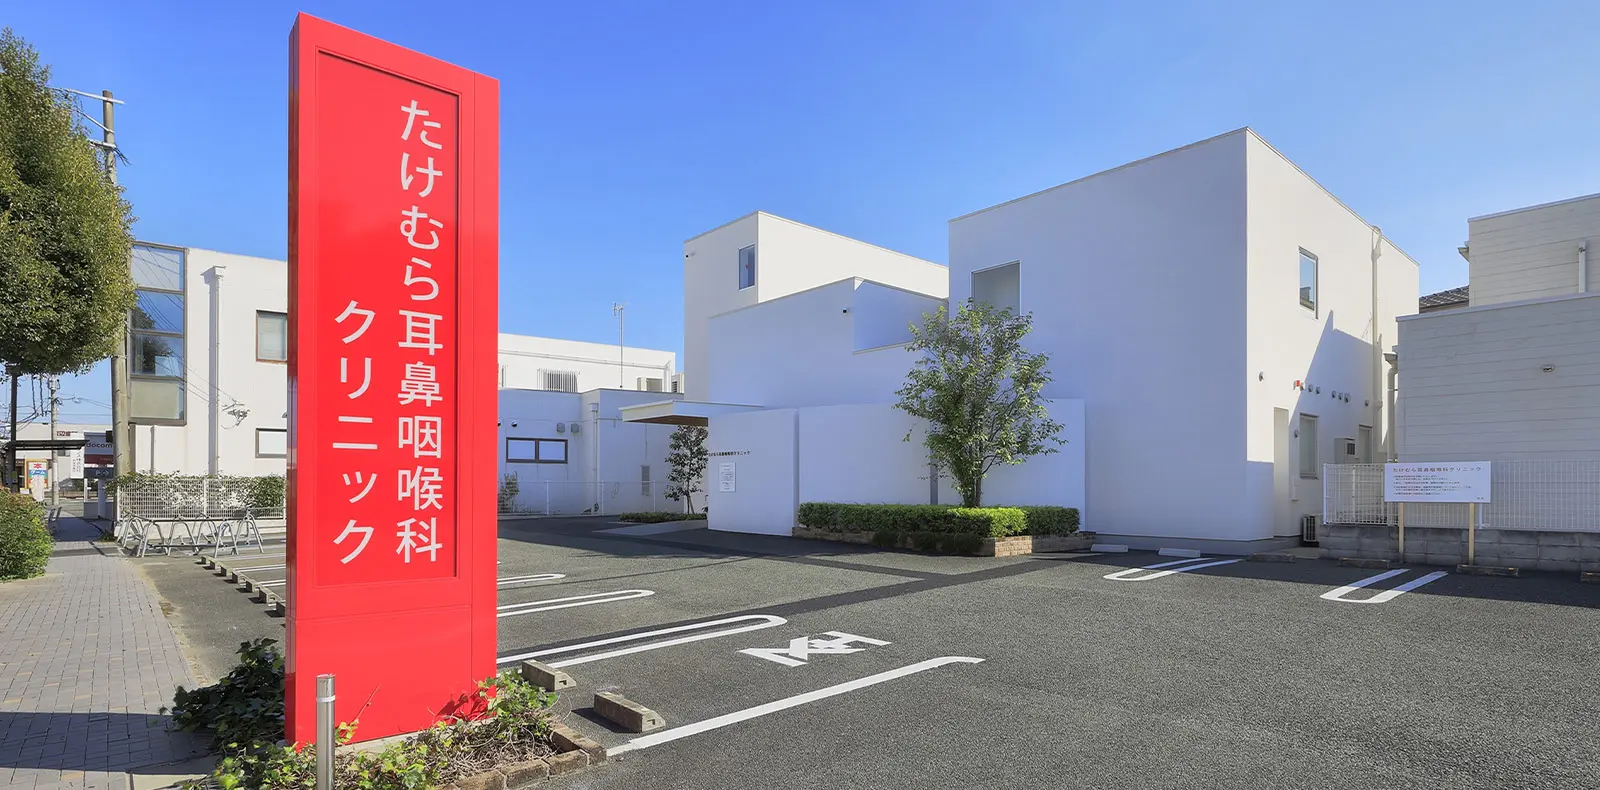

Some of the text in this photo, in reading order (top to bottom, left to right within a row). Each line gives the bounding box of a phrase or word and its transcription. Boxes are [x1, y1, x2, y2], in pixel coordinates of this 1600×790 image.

[332, 300, 377, 565] クリニック
[397, 99, 444, 563] たけむら耳鼻咽喉科
